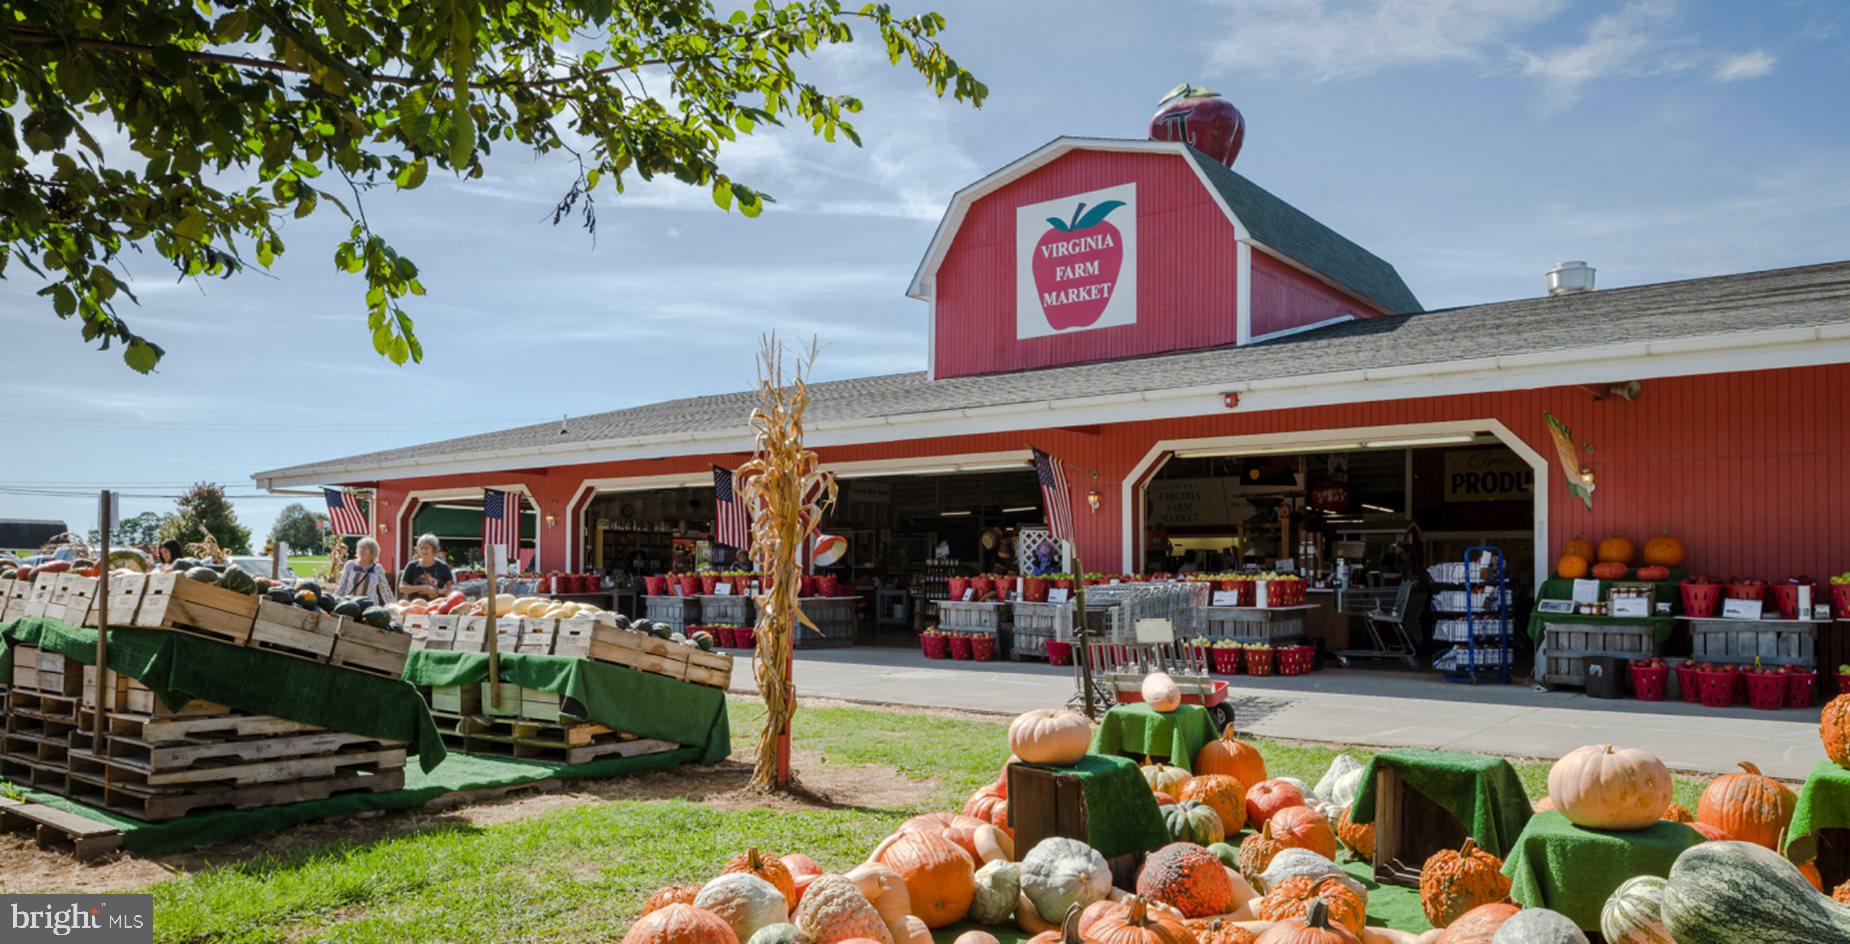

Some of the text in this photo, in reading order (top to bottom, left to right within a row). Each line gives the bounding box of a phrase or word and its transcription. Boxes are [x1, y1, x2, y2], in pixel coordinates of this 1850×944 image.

[1041, 233, 1114, 259] VIRGINIA
[1055, 260, 1100, 281] FARM
[1043, 283, 1112, 307] MARKET
[1158, 490, 1202, 502] VIRGINIA
[1166, 502, 1193, 512] FARM
[1160, 512, 1201, 523] MARKET
